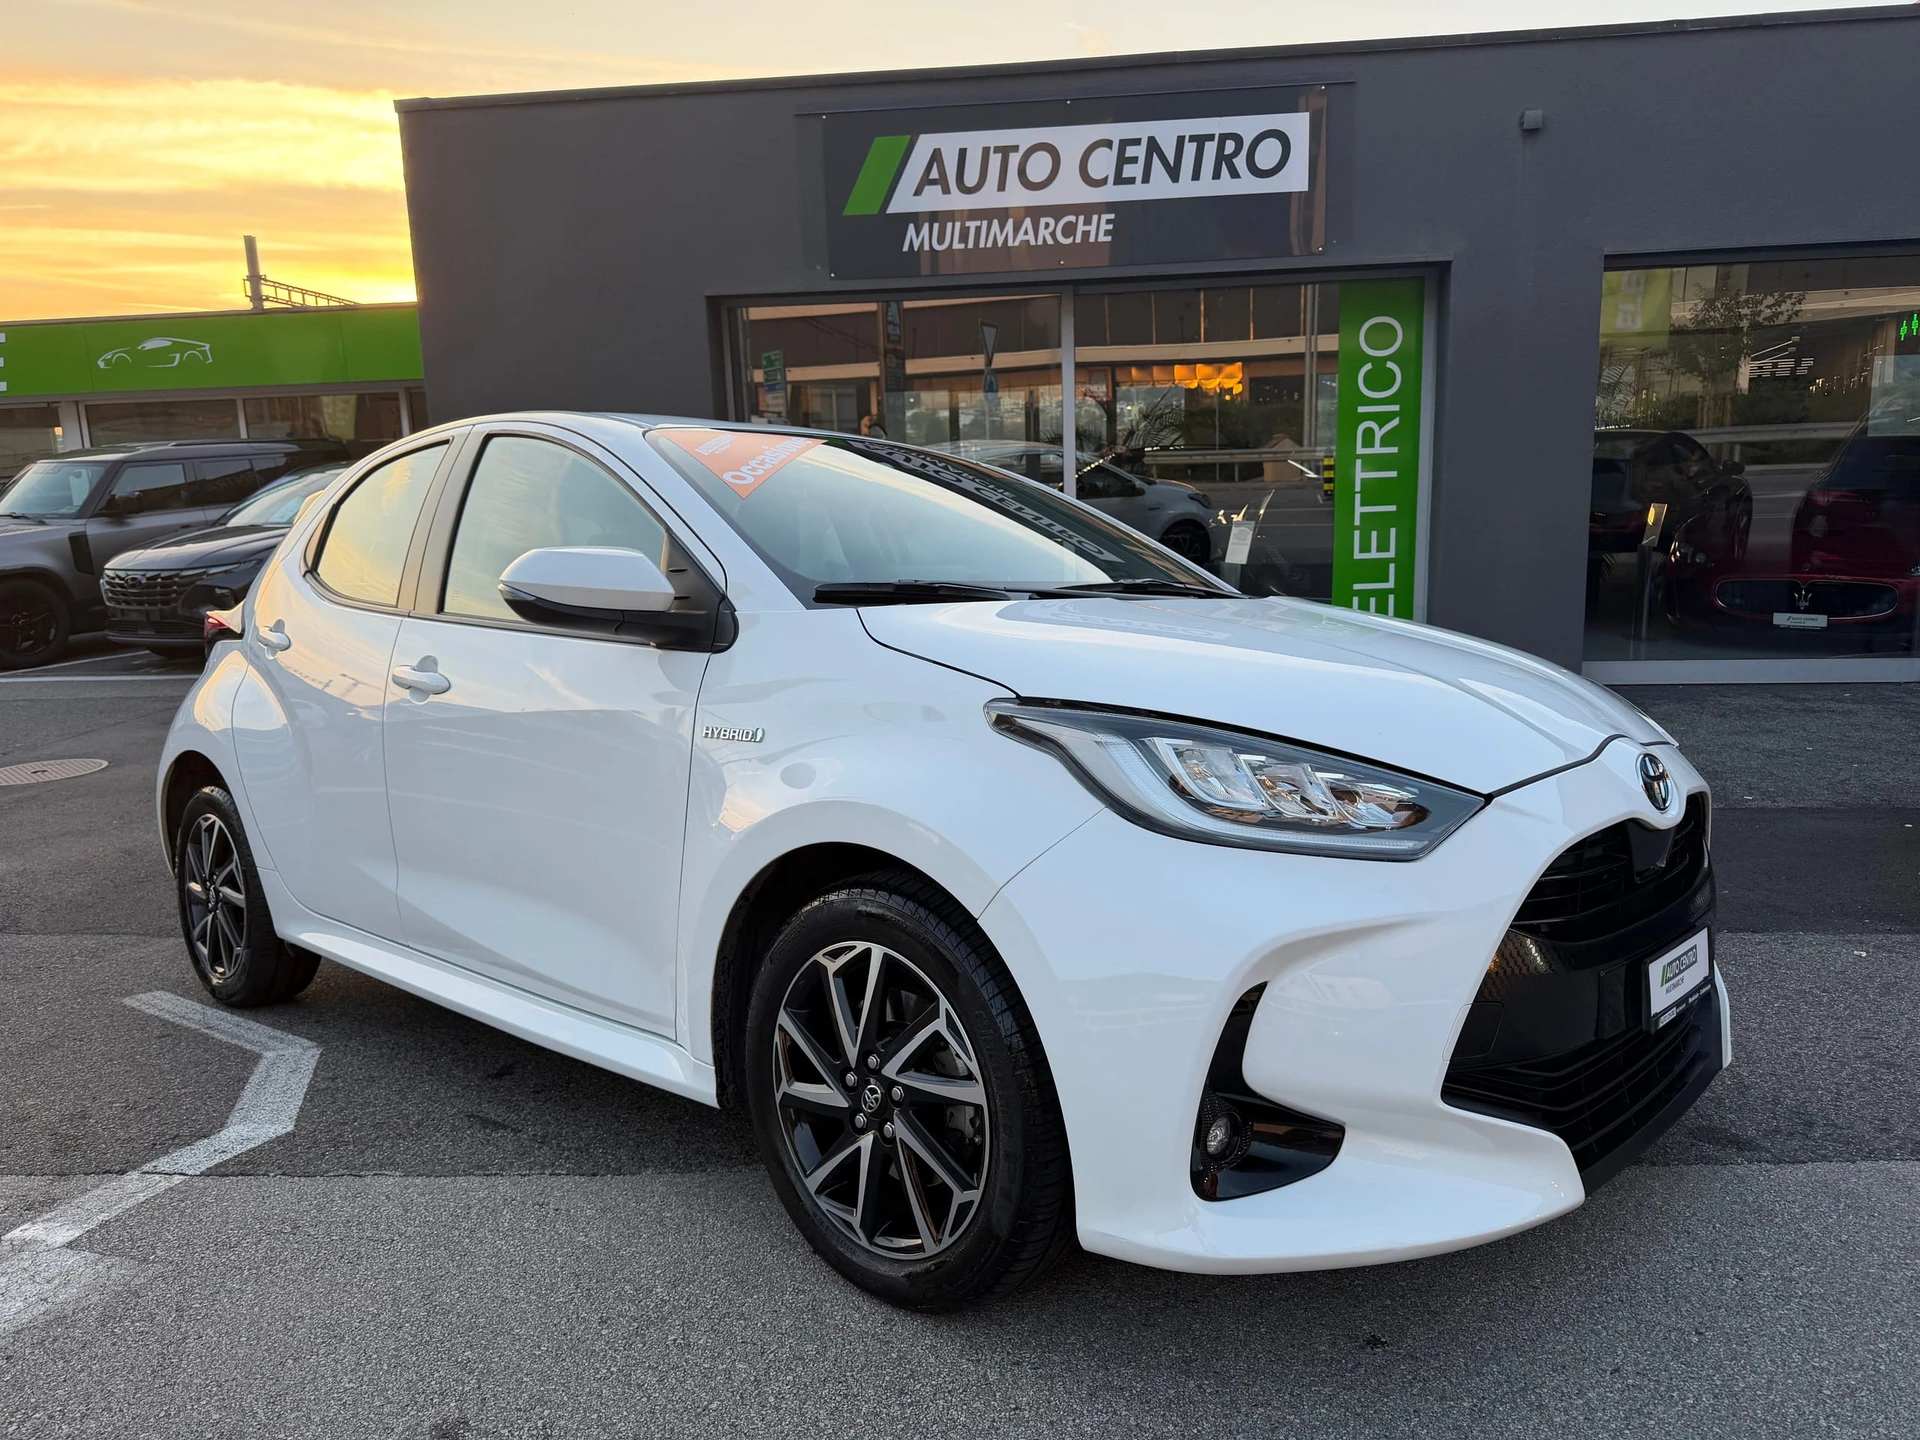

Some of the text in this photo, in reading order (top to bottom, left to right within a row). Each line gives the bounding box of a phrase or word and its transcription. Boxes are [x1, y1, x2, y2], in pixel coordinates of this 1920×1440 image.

[912, 128, 1291, 197] AUTO CENTRO
[902, 213, 1115, 252] MULTIMARCHE
[722, 437, 813, 485] Occasione
[1352, 315, 1404, 617] ELETTRICO
[702, 726, 754, 742] HYBRID
[1667, 948, 1697, 978] AUTO CENTRO
